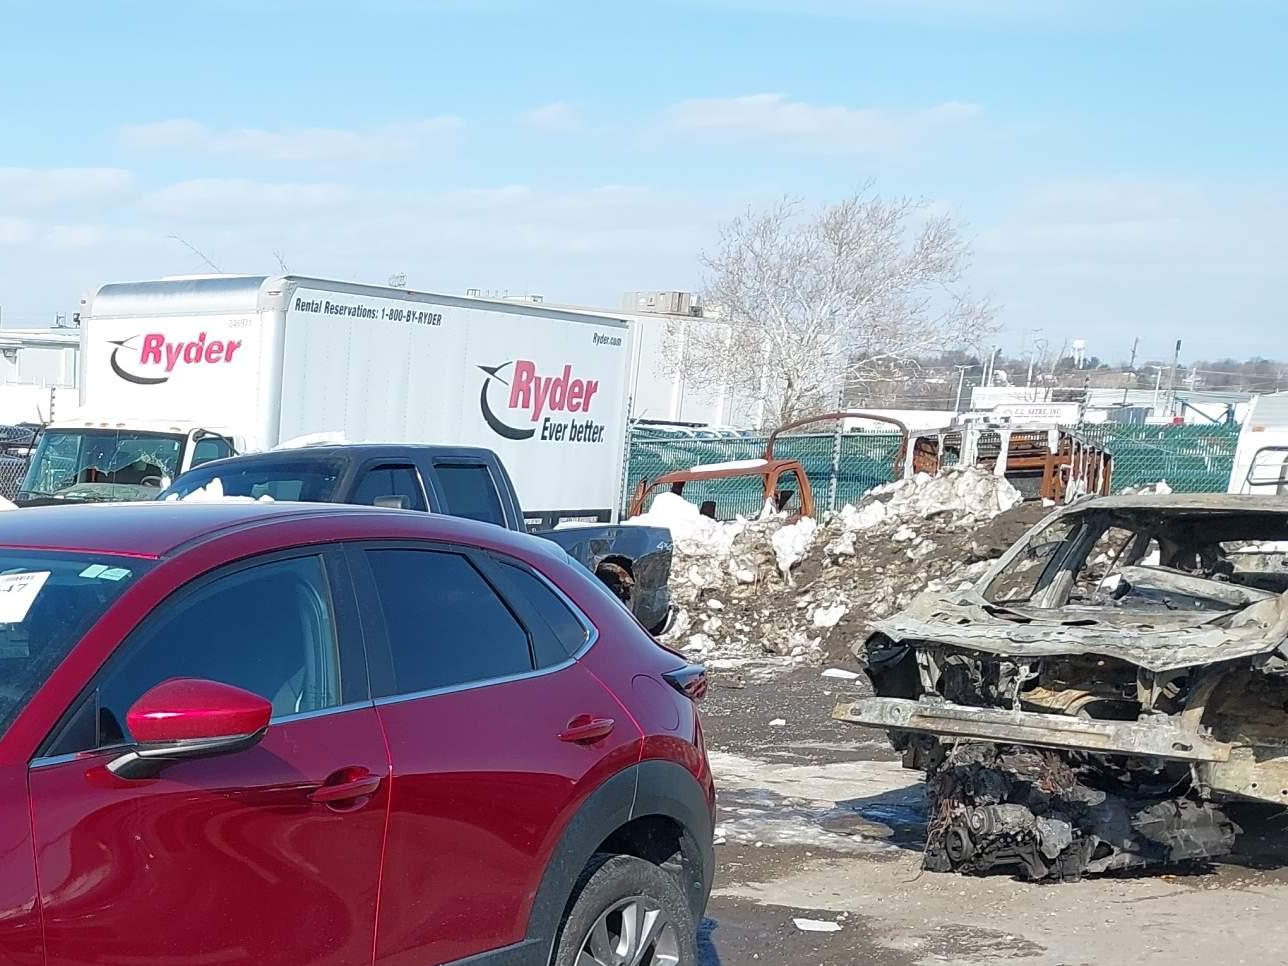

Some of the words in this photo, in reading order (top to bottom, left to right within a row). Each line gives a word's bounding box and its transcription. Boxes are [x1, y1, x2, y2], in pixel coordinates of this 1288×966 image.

[294, 297, 323, 313] Rental
[324, 300, 379, 320] Reservations:
[381, 307, 442, 327] 1-800-BY-RYDER
[139, 331, 243, 373] Ryder
[592, 332, 622, 347] Ryder.com
[509, 359, 599, 422] Ryder
[540, 417, 568, 441] Ever
[568, 418, 606, 443] better.
